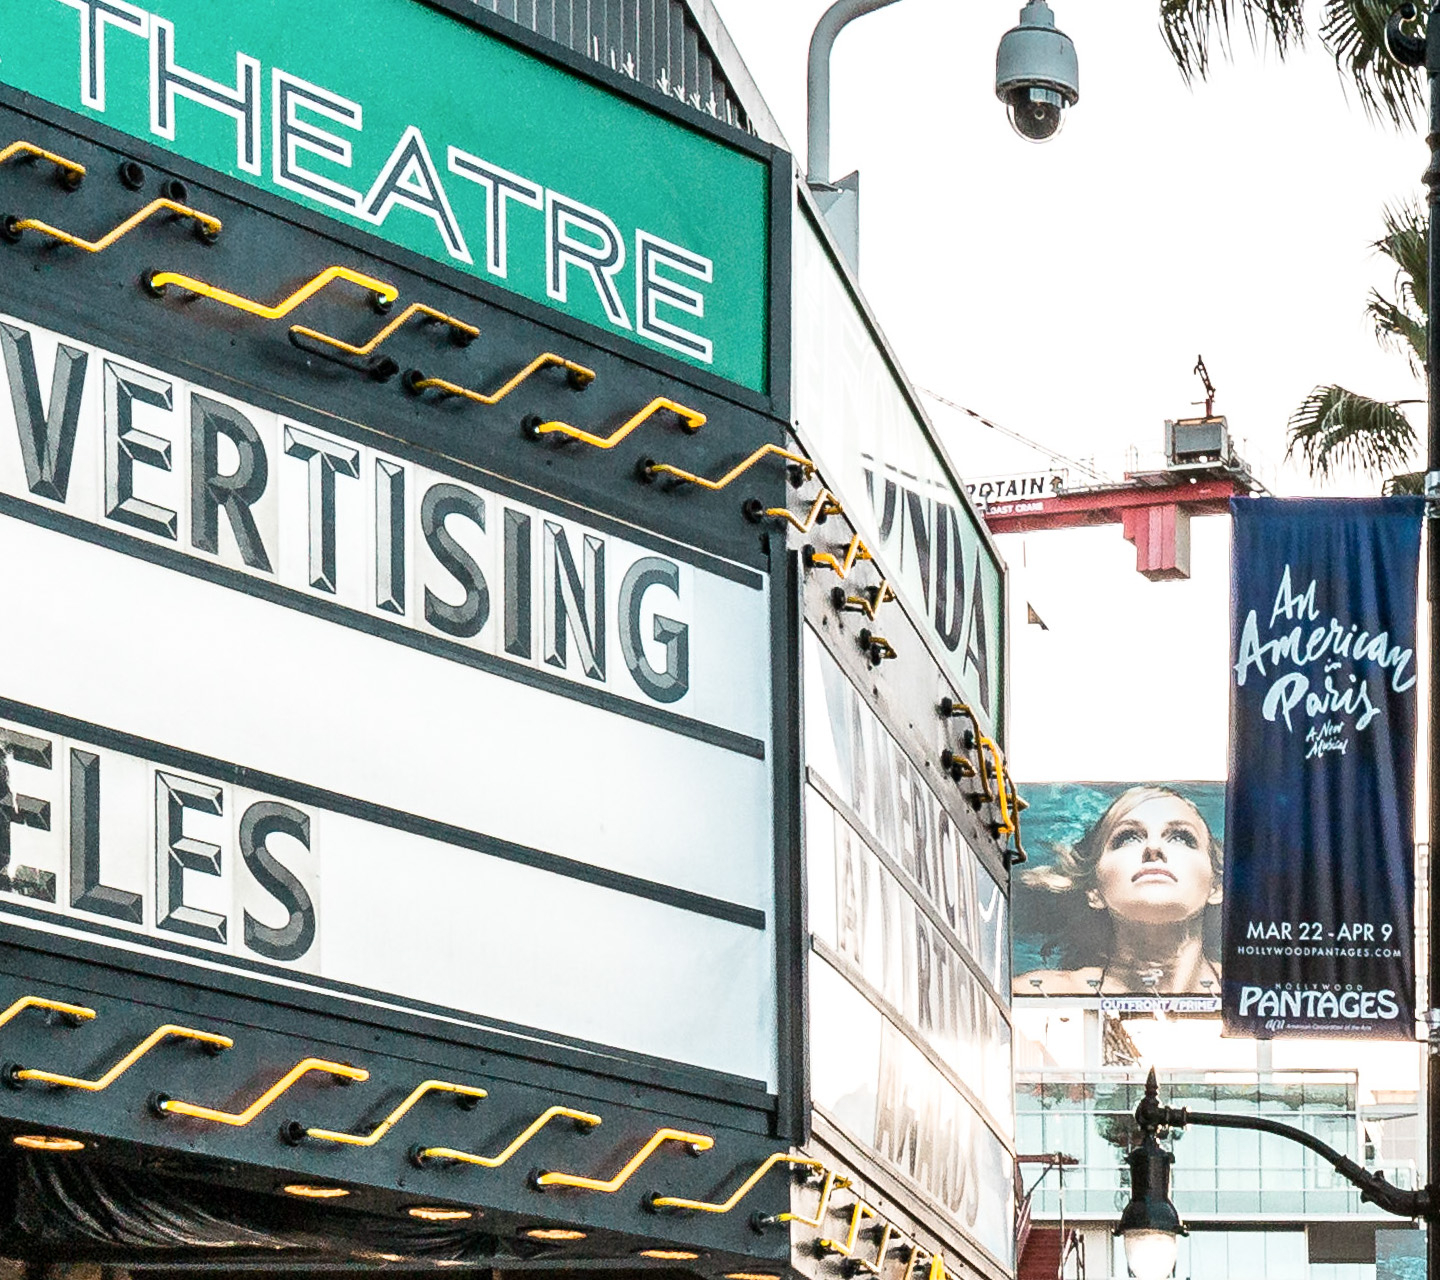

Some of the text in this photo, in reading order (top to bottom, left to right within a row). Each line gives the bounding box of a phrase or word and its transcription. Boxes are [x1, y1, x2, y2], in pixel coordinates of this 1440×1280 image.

[1269, 563, 1320, 629] An
[1233, 609, 1416, 693] American
[1324, 658, 1342, 673] in
[1262, 672, 1381, 733] Paris
[1317, 719, 1345, 741] New
[1306, 736, 1349, 759] Musical
[1246, 921, 1292, 940] MAR
[1299, 922, 1323, 941] 22
[1337, 922, 1375, 942] APR
[1381, 923, 1393, 942] 9
[1237, 946, 1402, 958] HOLLYWOODPANTAGES.COM
[1274, 982, 1363, 992] HOLLYWOOD
[1239, 986, 1399, 1019] PANTAGES
